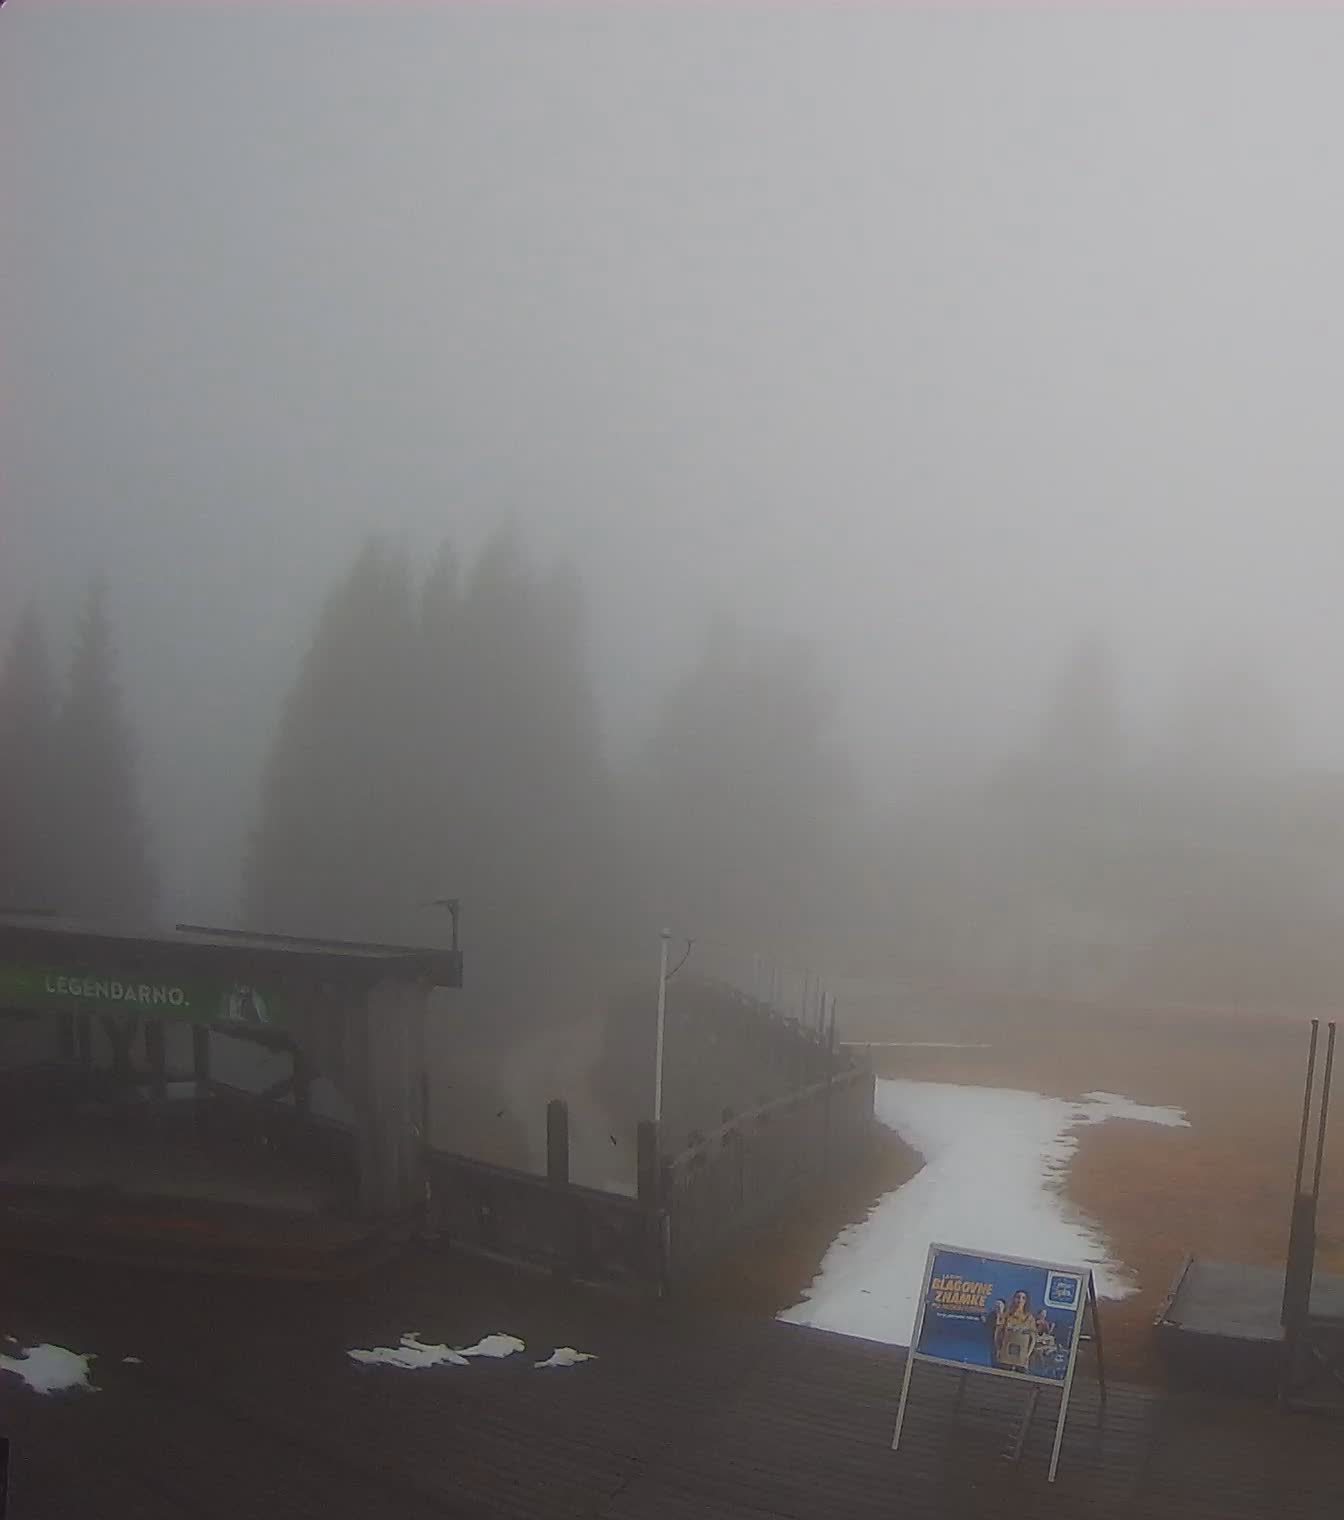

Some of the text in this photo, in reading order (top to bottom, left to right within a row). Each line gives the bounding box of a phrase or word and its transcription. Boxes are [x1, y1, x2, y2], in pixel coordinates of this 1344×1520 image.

[45, 975, 190, 1006] LEGENDARNO.
[932, 1278, 993, 1296] BLAGOVNE
[934, 1290, 987, 1307] ZNAMKE
